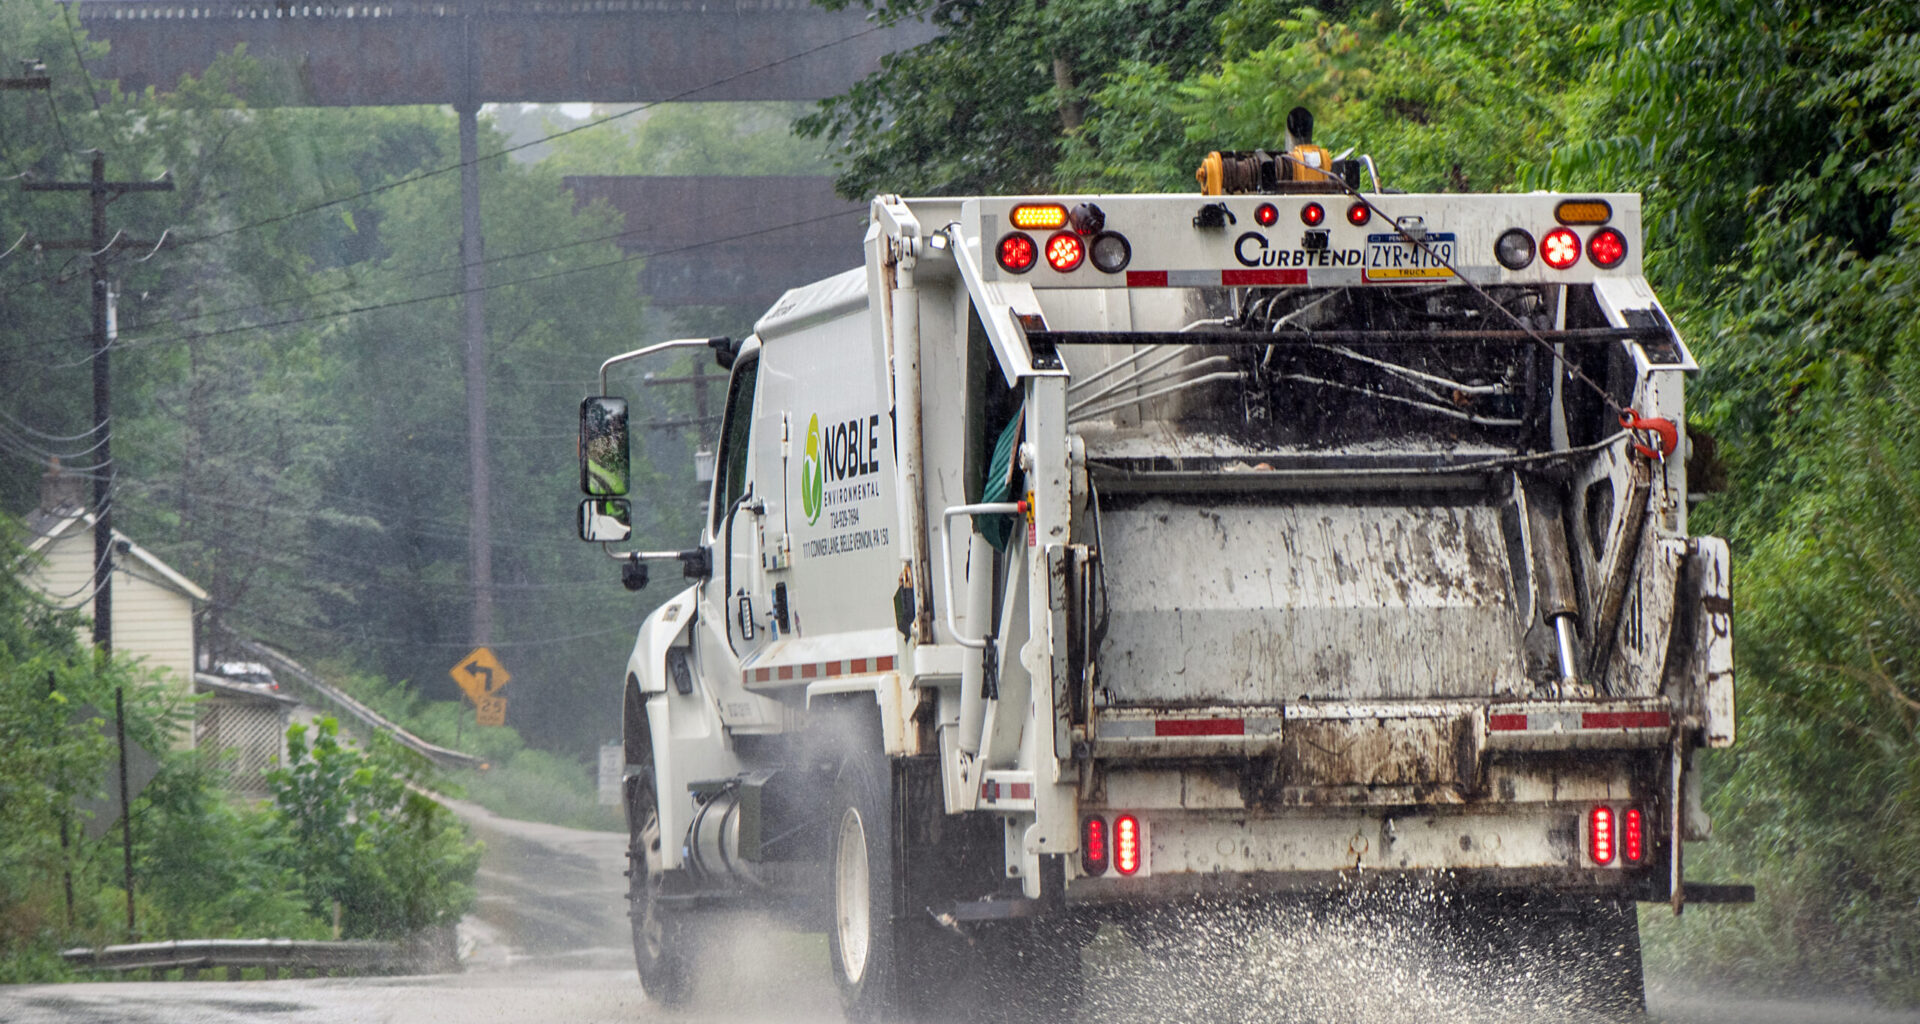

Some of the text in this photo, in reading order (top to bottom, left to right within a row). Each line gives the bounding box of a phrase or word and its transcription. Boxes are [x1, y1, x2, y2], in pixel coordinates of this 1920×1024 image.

[824, 414, 879, 483] NOBLE
[824, 482, 880, 507] ENVIRONMENTAL
[840, 533, 853, 552] BELLE
[873, 529, 880, 546] PA
[481, 699, 502, 712] 25
